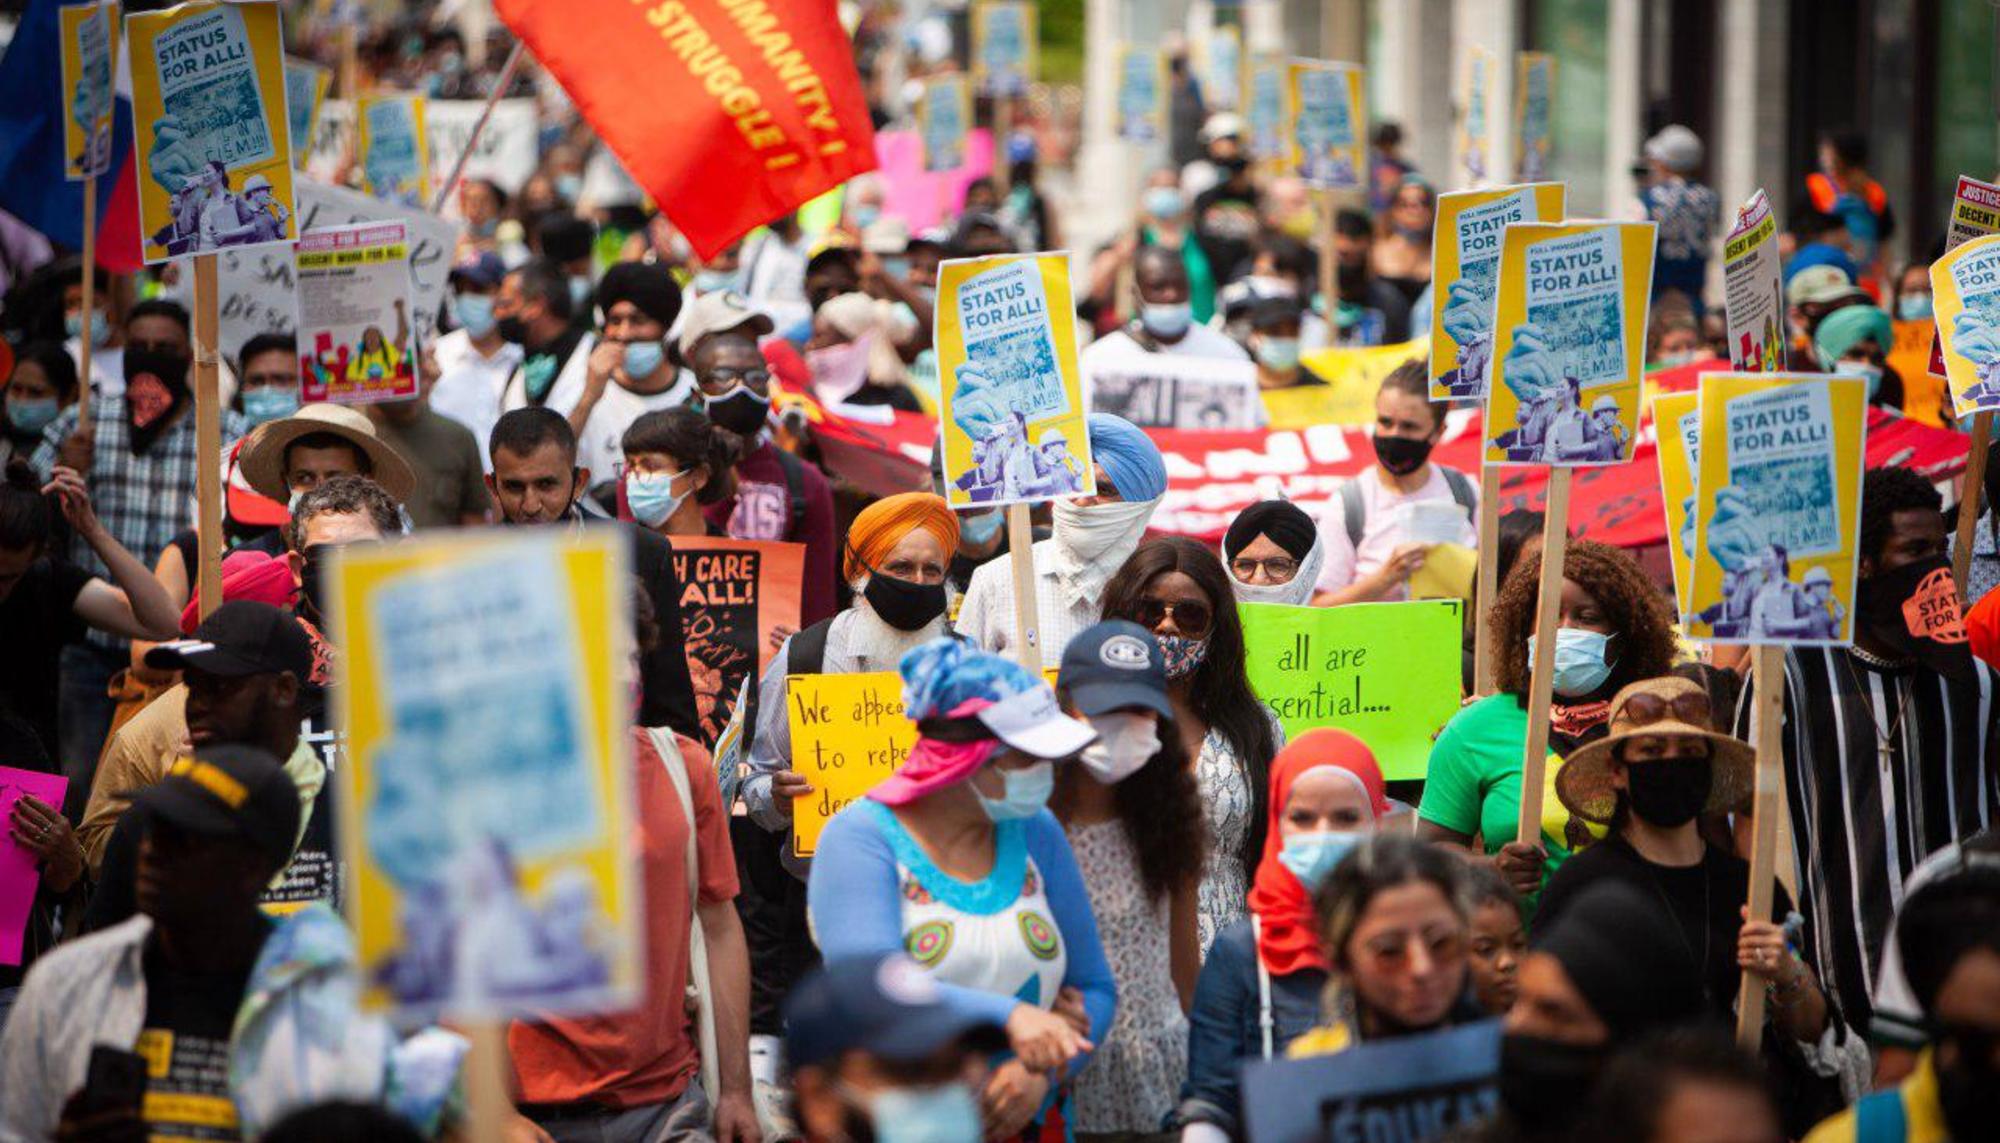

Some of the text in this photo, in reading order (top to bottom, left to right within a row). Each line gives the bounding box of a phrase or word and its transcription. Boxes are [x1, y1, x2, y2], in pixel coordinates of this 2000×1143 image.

[158, 27, 227, 66] STATUS
[162, 58, 198, 84] FOR
[203, 41, 246, 69] ALL!
[645, 0, 787, 148] STRUGGLE
[717, 0, 839, 131] MANITY
[1961, 184, 2000, 207] JUSTICE
[1460, 209, 1522, 237] STATUS
[1958, 204, 1996, 227] DECENT
[1462, 234, 1497, 253] FOR
[1530, 248, 1603, 275] STATUS
[1532, 275, 1572, 293] FOR
[1577, 264, 1617, 287] ALL!
[1959, 271, 1997, 289] FOR
[961, 281, 1026, 312] STATUS
[965, 308, 1003, 330] FOR
[1007, 296, 1042, 320] ALL!
[1731, 404, 1811, 433] STATUS
[1733, 432, 1775, 453] FOR
[1780, 422, 1827, 446] ALL!
[696, 554, 753, 583] CARE
[679, 580, 754, 607] ALL!
[1918, 592, 1959, 617] STAT
[1923, 609, 1957, 631] FOR
[1278, 633, 1367, 672] all are
[796, 689, 831, 725] We
[1257, 675, 1391, 720] sential....
[808, 739, 845, 770] to
